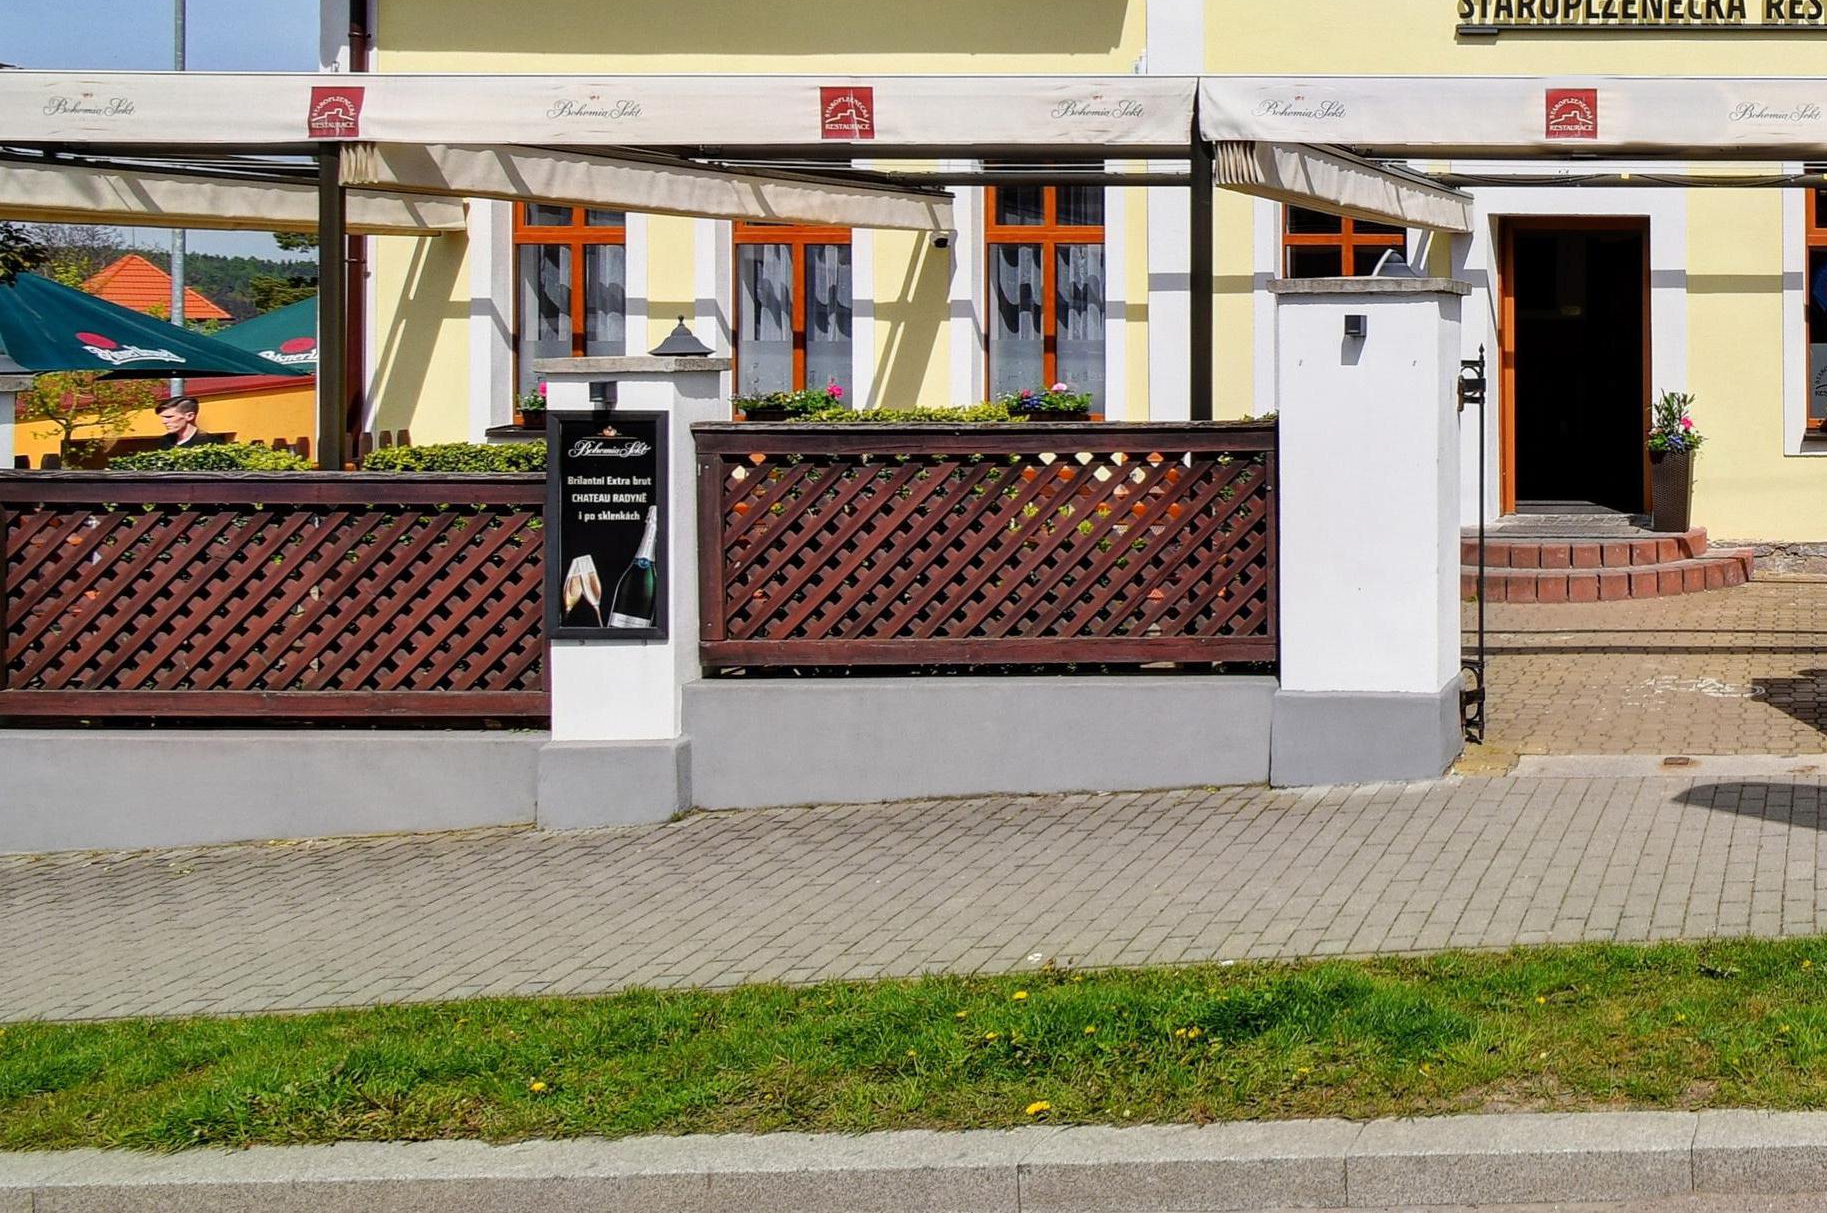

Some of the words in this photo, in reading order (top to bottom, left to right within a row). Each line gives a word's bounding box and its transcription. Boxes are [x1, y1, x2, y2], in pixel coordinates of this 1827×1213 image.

[43, 96, 102, 116] Bohemia
[104, 98, 135, 116] Sekt
[546, 99, 609, 118] Bohemia
[609, 99, 642, 119] Sekt
[1051, 99, 1112, 118] Bohemia
[1112, 99, 1145, 119] Sekt
[1253, 100, 1315, 118] Bohemia
[1313, 100, 1346, 119] Sekt
[1729, 102, 1790, 121] Bohemia
[1789, 103, 1821, 121] Sekt
[311, 122, 356, 130] RESTAURACE
[568, 440, 621, 457] Bohemia
[620, 440, 651, 457] Sekt
[606, 476, 631, 485] Extra
[632, 476, 652, 486] brut
[571, 493, 611, 503] CHATEAU
[584, 513, 596, 523] po
[597, 510, 641, 521] sklenkách
